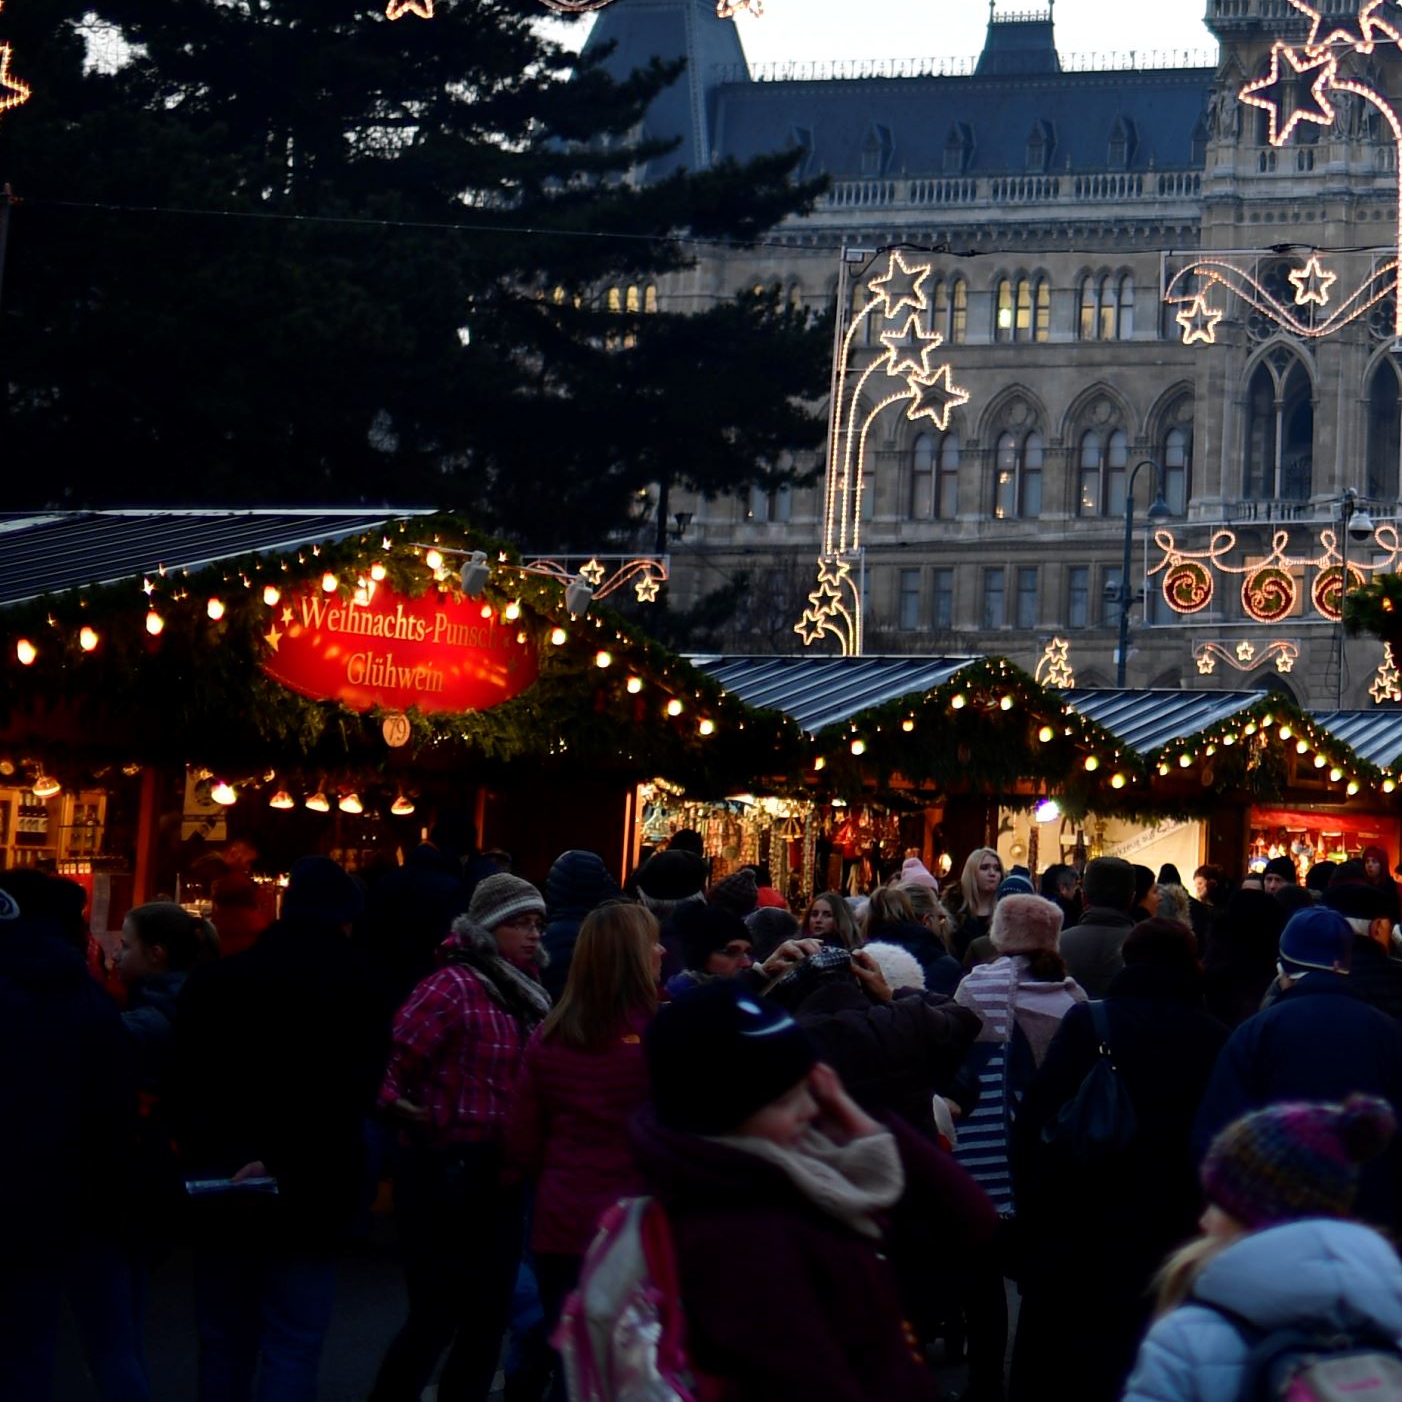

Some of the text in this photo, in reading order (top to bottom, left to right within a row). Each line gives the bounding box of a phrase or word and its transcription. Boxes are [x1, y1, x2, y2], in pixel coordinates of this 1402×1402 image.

[302, 596, 497, 649] Weihnachts-Punsch
[347, 651, 444, 692] Glühwein
[388, 717, 407, 741] 79
